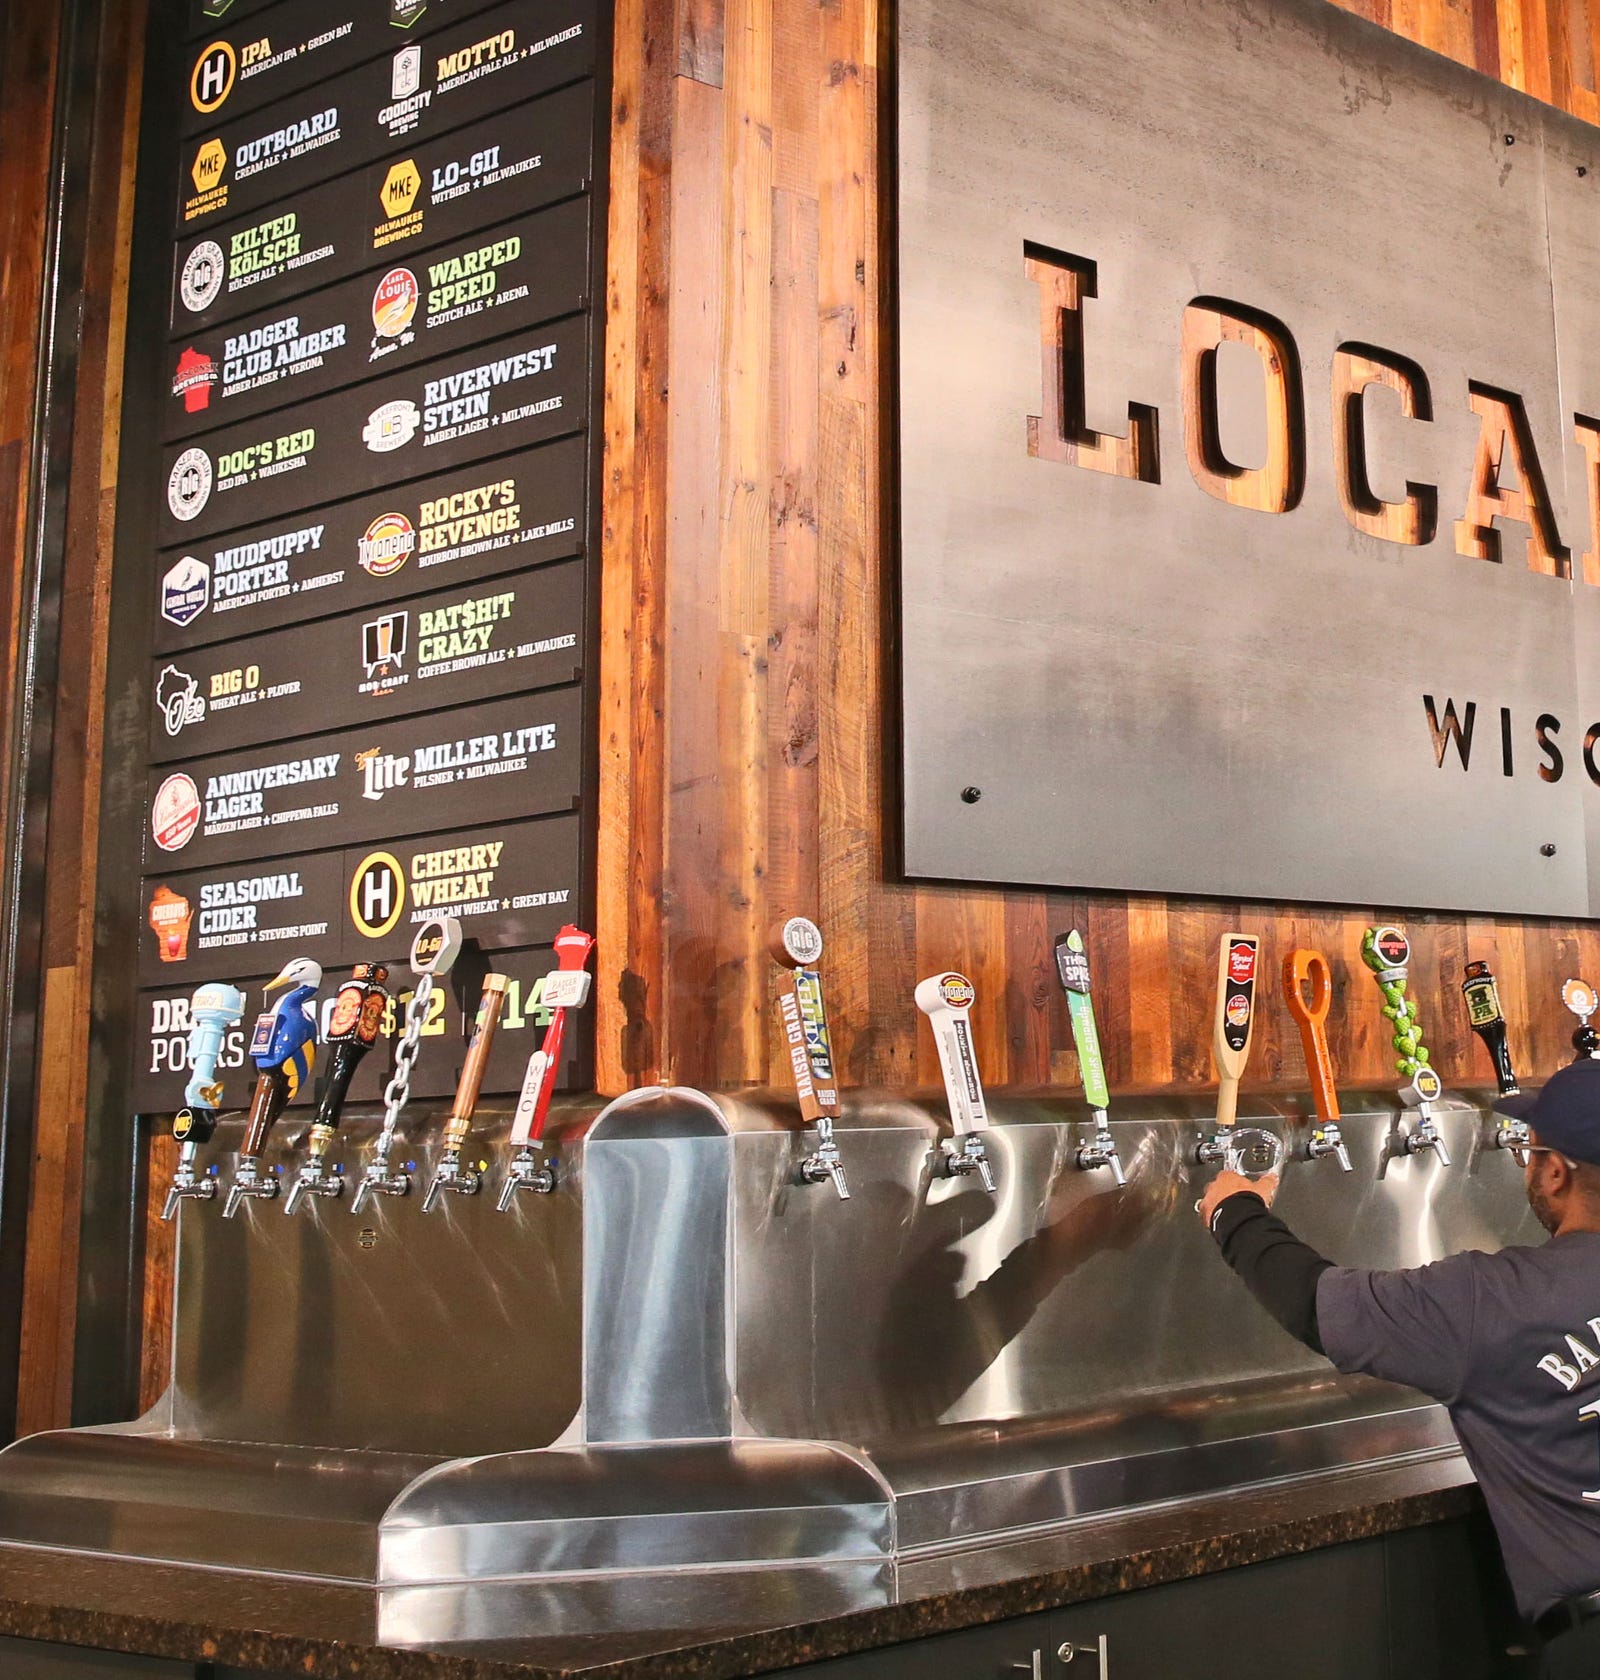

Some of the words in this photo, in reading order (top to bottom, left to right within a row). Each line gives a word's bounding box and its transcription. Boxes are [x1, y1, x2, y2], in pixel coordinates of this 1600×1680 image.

[240, 54, 283, 80] AMERICAN
[284, 48, 297, 61] IPA
[308, 30, 335, 50] GREEN
[336, 22, 353, 38] BAY
[241, 38, 272, 68] IPA
[437, 30, 515, 81] MOTTO
[437, 67, 480, 94] AMERICAN
[481, 59, 501, 76] PALE
[502, 52, 519, 68] ALE
[530, 24, 582, 55] MILWAUKEE
[235, 161, 264, 180] CREAM
[264, 154, 279, 169] ALE
[290, 128, 341, 158] MILWAUKEE
[236, 108, 338, 167] OUTBOARD
[200, 154, 219, 177] MKE
[431, 182, 470, 205] WITBIER
[482, 155, 541, 186] MILWAUKEE
[432, 146, 500, 191] LO-GII
[389, 176, 412, 202] MKE
[230, 213, 296, 256] KILTED
[374, 210, 424, 236] MILWAUKEE
[260, 266, 277, 280] ALE
[287, 244, 335, 270] WAUKESHA
[428, 237, 521, 288] WARPED
[380, 280, 412, 300] LOUIE
[426, 307, 464, 328] SCOTCH
[464, 300, 483, 315] ALE
[495, 285, 529, 305] ARENA
[428, 271, 496, 314] SPEED
[223, 349, 272, 384] CLUB
[274, 323, 346, 367] AMBER
[224, 316, 299, 361] BADGER
[222, 382, 251, 398] AMBER
[252, 371, 278, 388] LAGER
[289, 356, 323, 375] VERONA
[424, 344, 556, 406] RIVERWEST
[423, 391, 490, 432] STEIN
[423, 429, 457, 447] AMBER
[458, 418, 489, 436] LAGER
[501, 396, 563, 424] MILWAUKEE
[217, 479, 233, 492] RED
[235, 473, 248, 487] IPA
[259, 455, 307, 479] WAUKESHA
[218, 441, 272, 478] DOC'S
[276, 429, 315, 460] RED
[419, 479, 515, 527] ROCKY'S
[214, 525, 324, 575] MUDPUPPY
[419, 505, 520, 553] REVENGE
[419, 549, 460, 568] BOURBON
[460, 539, 493, 558] BROWN
[493, 535, 510, 547] ALE
[521, 526, 545, 542] LAKE
[546, 518, 575, 535] MILLS
[213, 560, 289, 599] PORTER
[213, 594, 257, 613] AMERICAN
[257, 585, 290, 603] PORTER
[301, 571, 345, 591] AMHERST
[418, 592, 515, 637] BAT$H!T
[417, 660, 452, 679] COFFEE
[452, 654, 488, 671] BROWN
[488, 650, 506, 662] ALE
[517, 634, 576, 658] MILWAUKEE
[418, 625, 493, 664] CRAZY
[209, 697, 239, 711] WHEAT
[240, 691, 257, 704] ALE
[267, 681, 301, 698] PLOVER
[210, 669, 243, 697] BIG
[245, 665, 259, 689] O
[414, 735, 499, 773] MILLER
[502, 723, 556, 757] LITE
[205, 754, 340, 799] ANNIVERSARY
[362, 755, 410, 800] Lite
[414, 771, 454, 789] PILSNER
[466, 757, 527, 779] MILWAUKEE
[205, 792, 263, 822] LAGER
[237, 817, 262, 831] LAGER
[271, 809, 313, 824] CHIPPEWA
[313, 803, 339, 818] FALLS
[411, 842, 503, 880] CHERRY
[200, 873, 303, 909] SEASONAL
[410, 872, 494, 907] WHEAT
[410, 906, 462, 923] AMERICAN
[463, 899, 500, 915] WHEAT
[512, 895, 547, 909] GREEN
[548, 890, 569, 904] BAY
[199, 905, 257, 935] CIDER
[199, 936, 222, 948] HARD
[222, 933, 248, 946] CIDER
[259, 926, 299, 941] STEVENS
[300, 923, 328, 936] POINT
[497, 977, 555, 1029] 14
[780, 992, 803, 1044] GRAIN
[797, 976, 822, 1051] KILTED
[791, 1046, 814, 1099] RAISED
[1419, 1078, 1437, 1092] MKE
